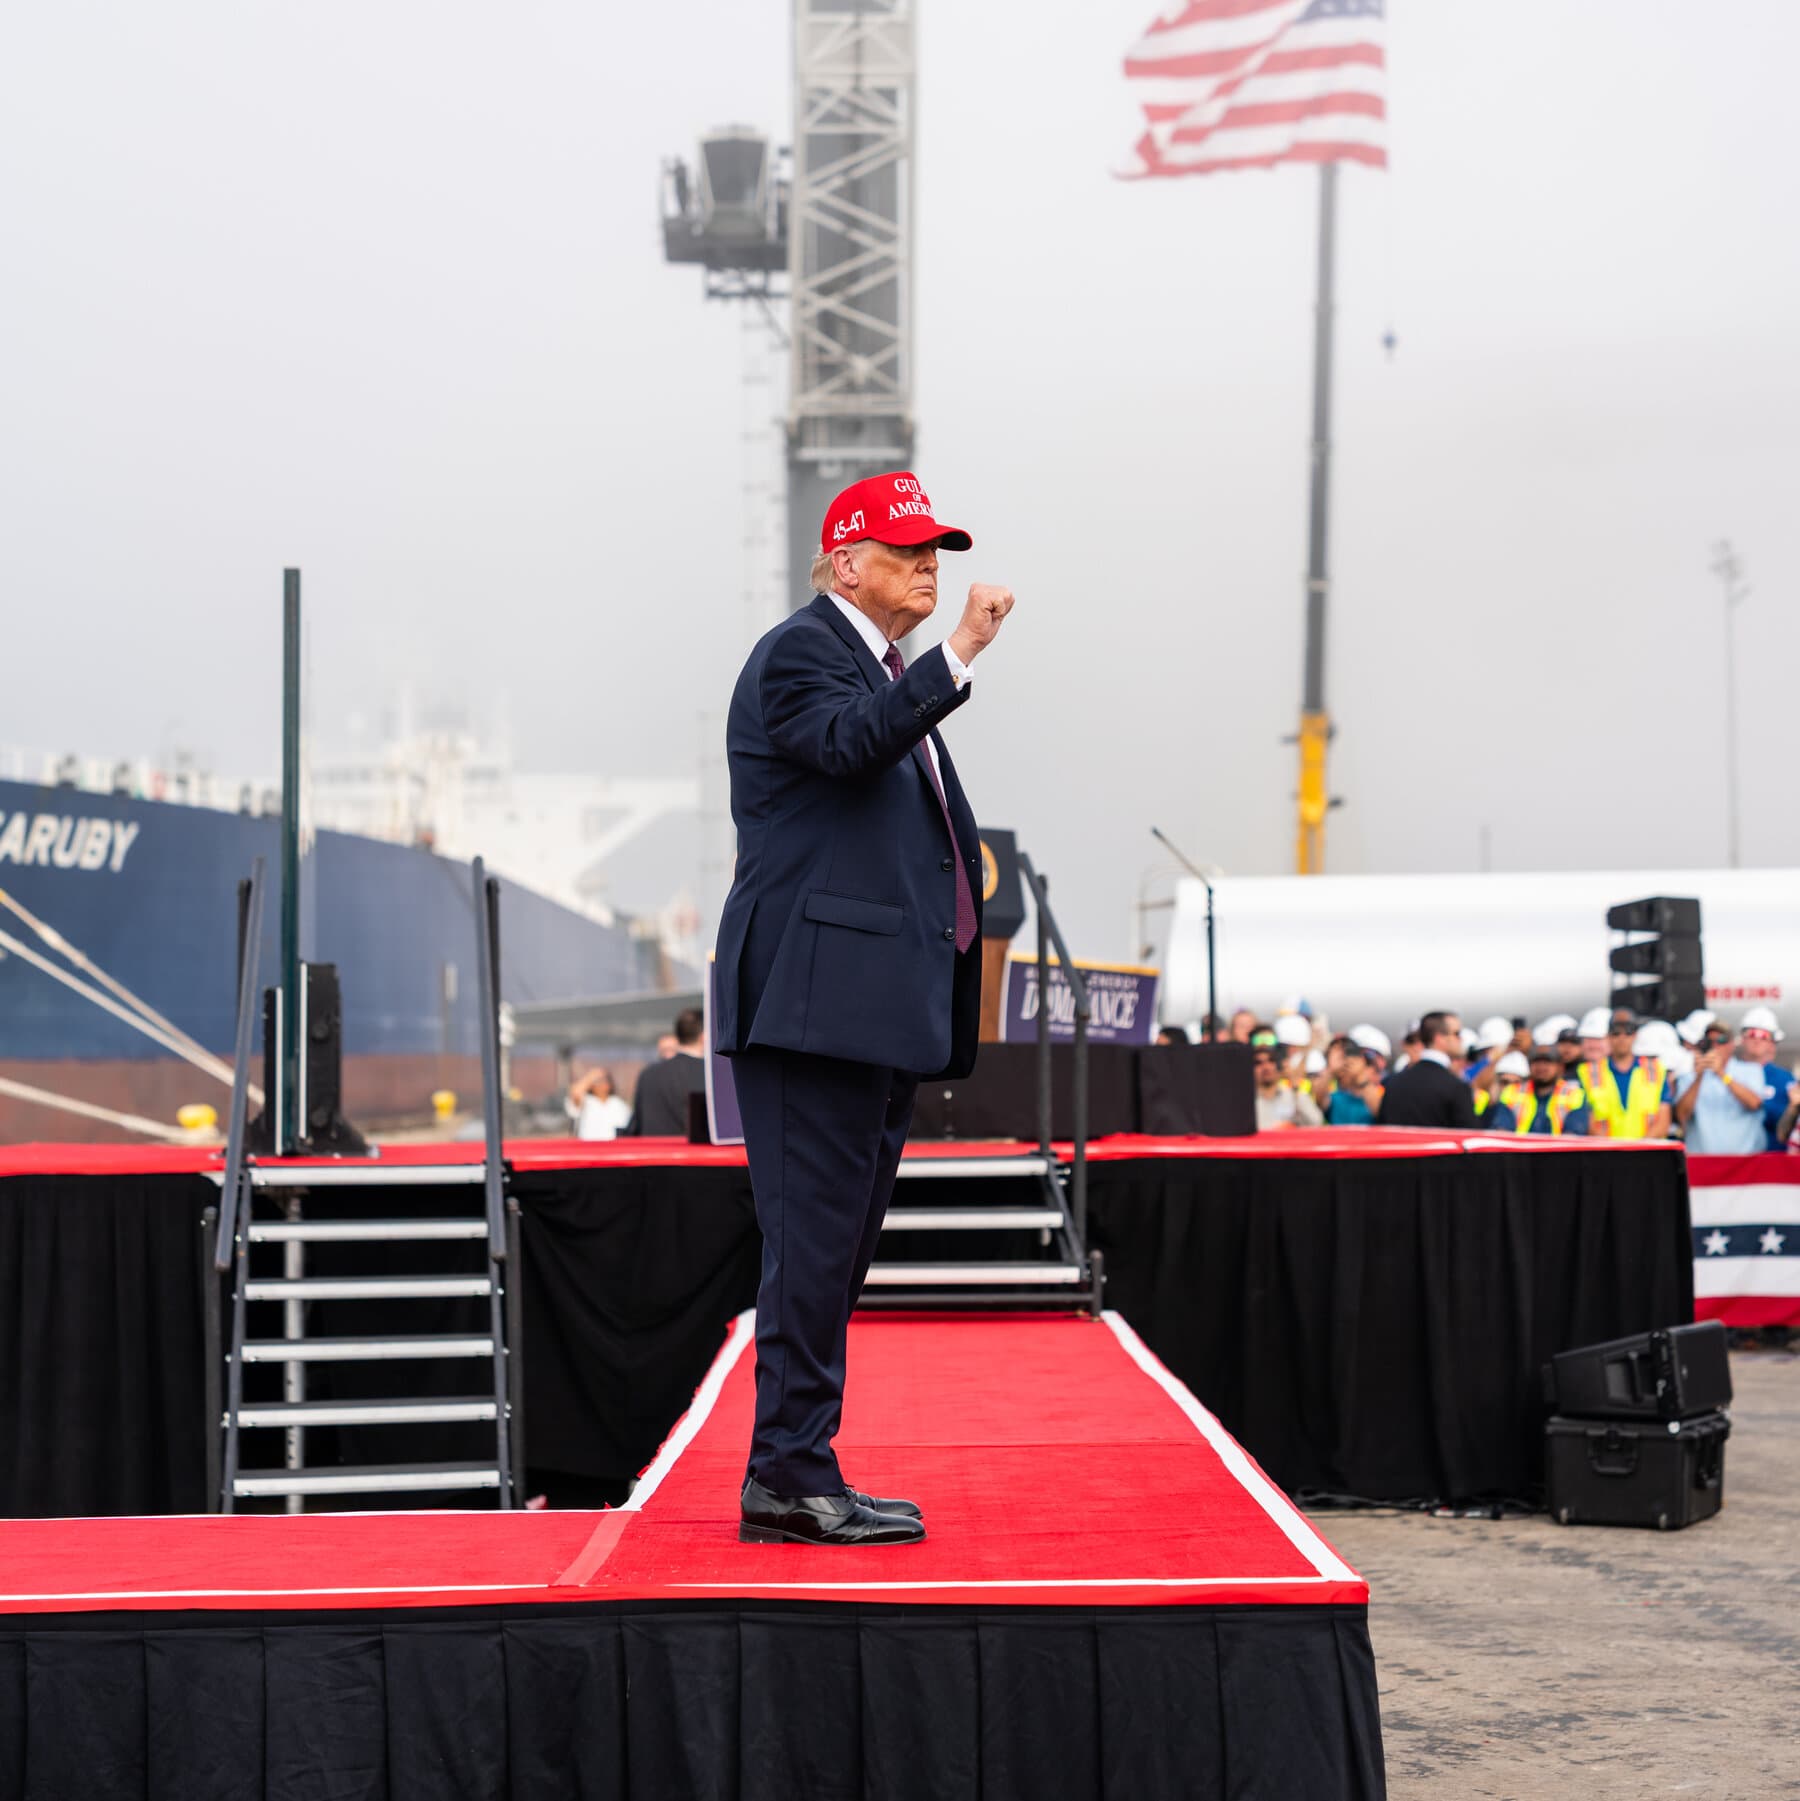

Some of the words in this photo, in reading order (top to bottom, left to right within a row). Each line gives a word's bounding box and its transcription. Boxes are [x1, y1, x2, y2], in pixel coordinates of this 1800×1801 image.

[832, 510, 866, 541] 45-47
[888, 501, 935, 520] AMERI
[0, 811, 139, 873] ARUBY
